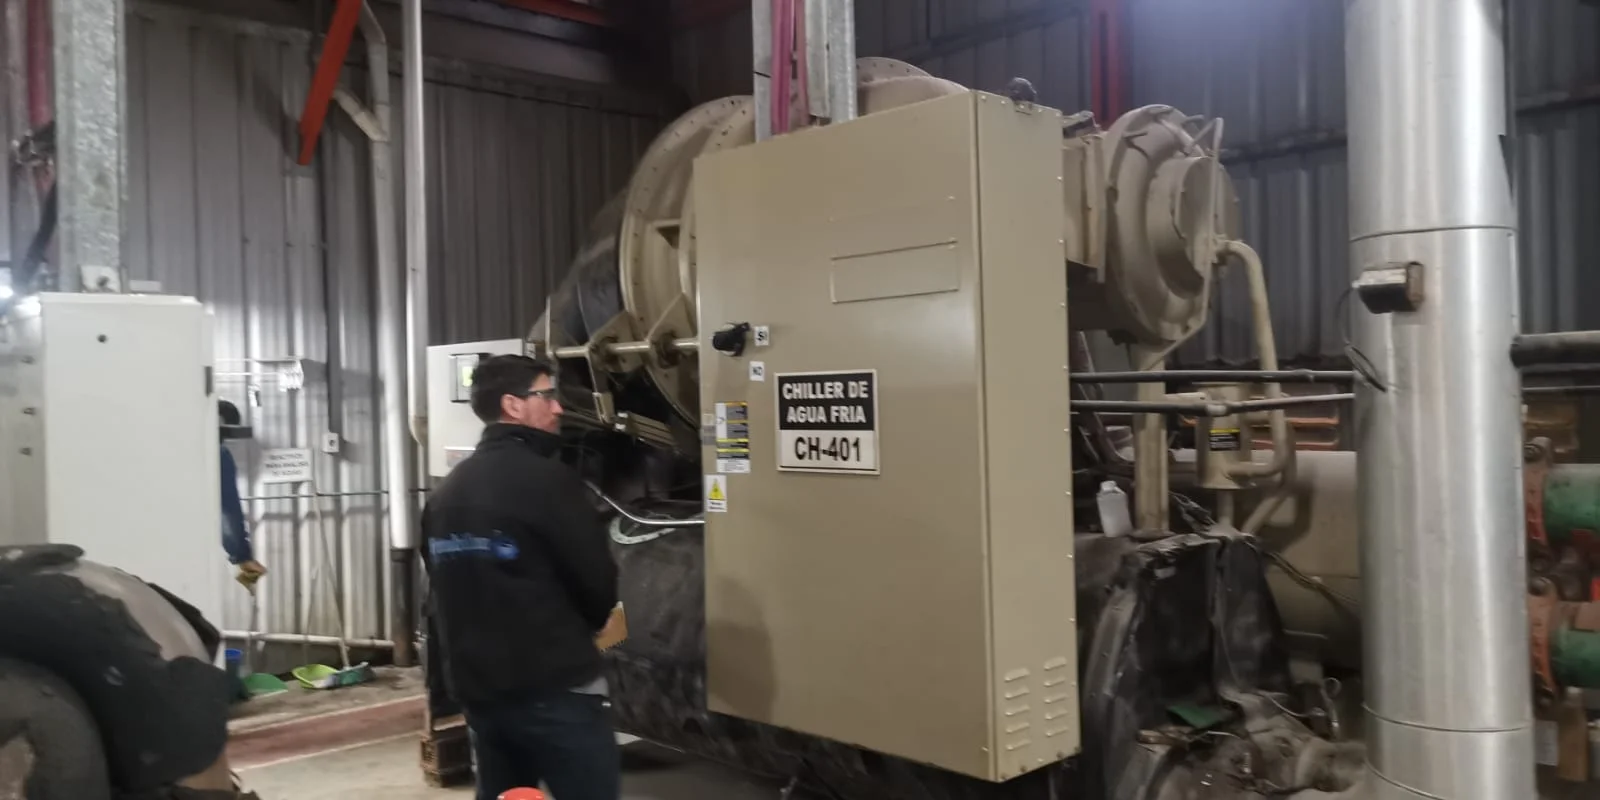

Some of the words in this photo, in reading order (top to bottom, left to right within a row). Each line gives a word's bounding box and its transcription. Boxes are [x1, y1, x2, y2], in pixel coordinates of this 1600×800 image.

[782, 381, 845, 400] CHILLER
[848, 380, 869, 398] DE
[786, 405, 827, 423] AGUA
[830, 405, 867, 423] FRIA
[794, 436, 861, 462] CH-401
